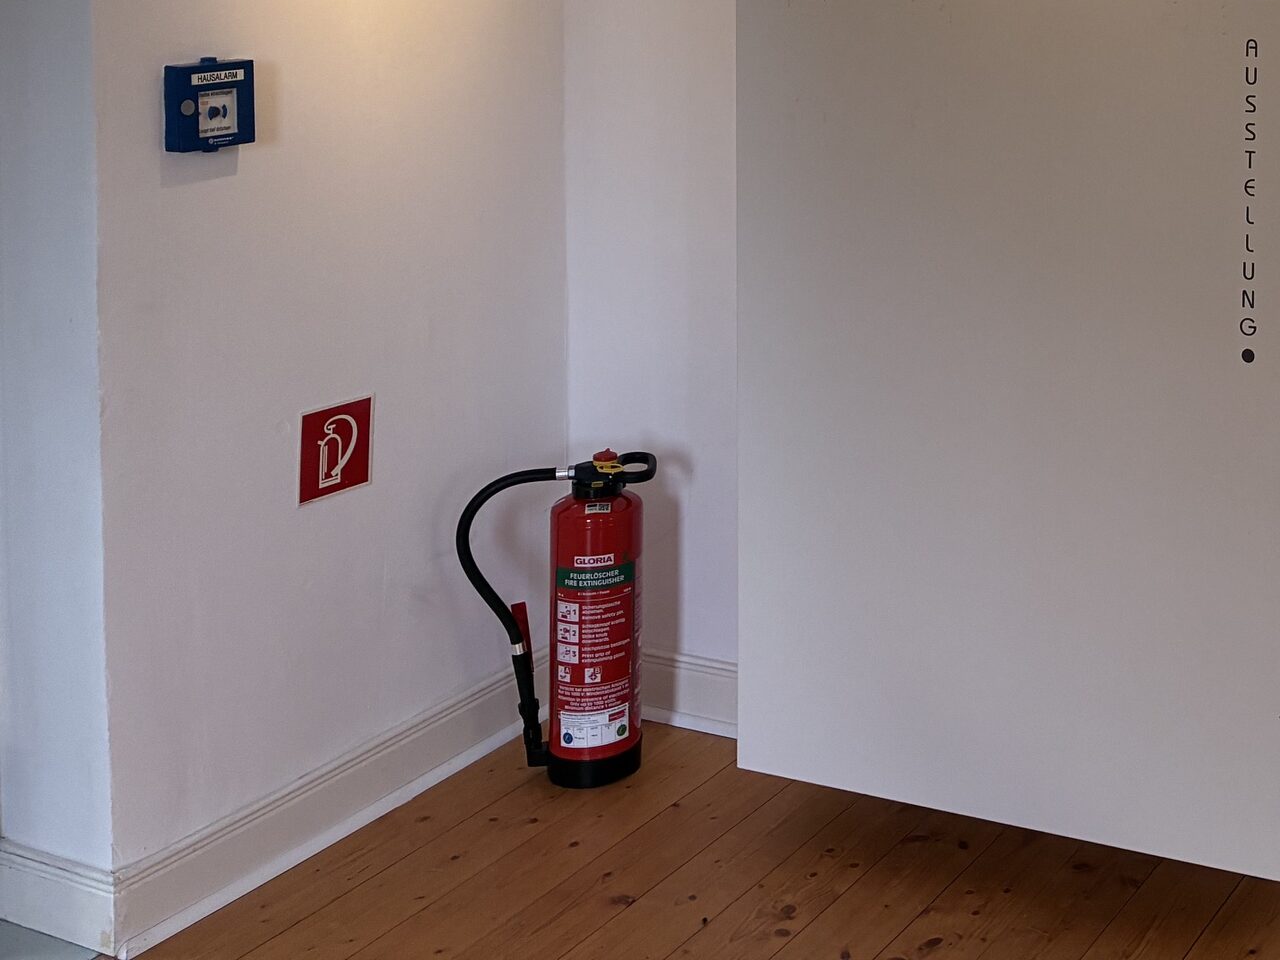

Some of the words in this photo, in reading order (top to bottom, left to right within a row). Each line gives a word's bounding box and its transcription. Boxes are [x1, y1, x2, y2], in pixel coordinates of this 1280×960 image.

[198, 72, 238, 83] HAUSALARM
[1240, 38, 1258, 336] AUSSTELLUNG
[576, 556, 613, 565] GLORIA
[570, 570, 619, 580] FEUERLÖSCHER
[579, 575, 625, 587] EXTINGUISHER
